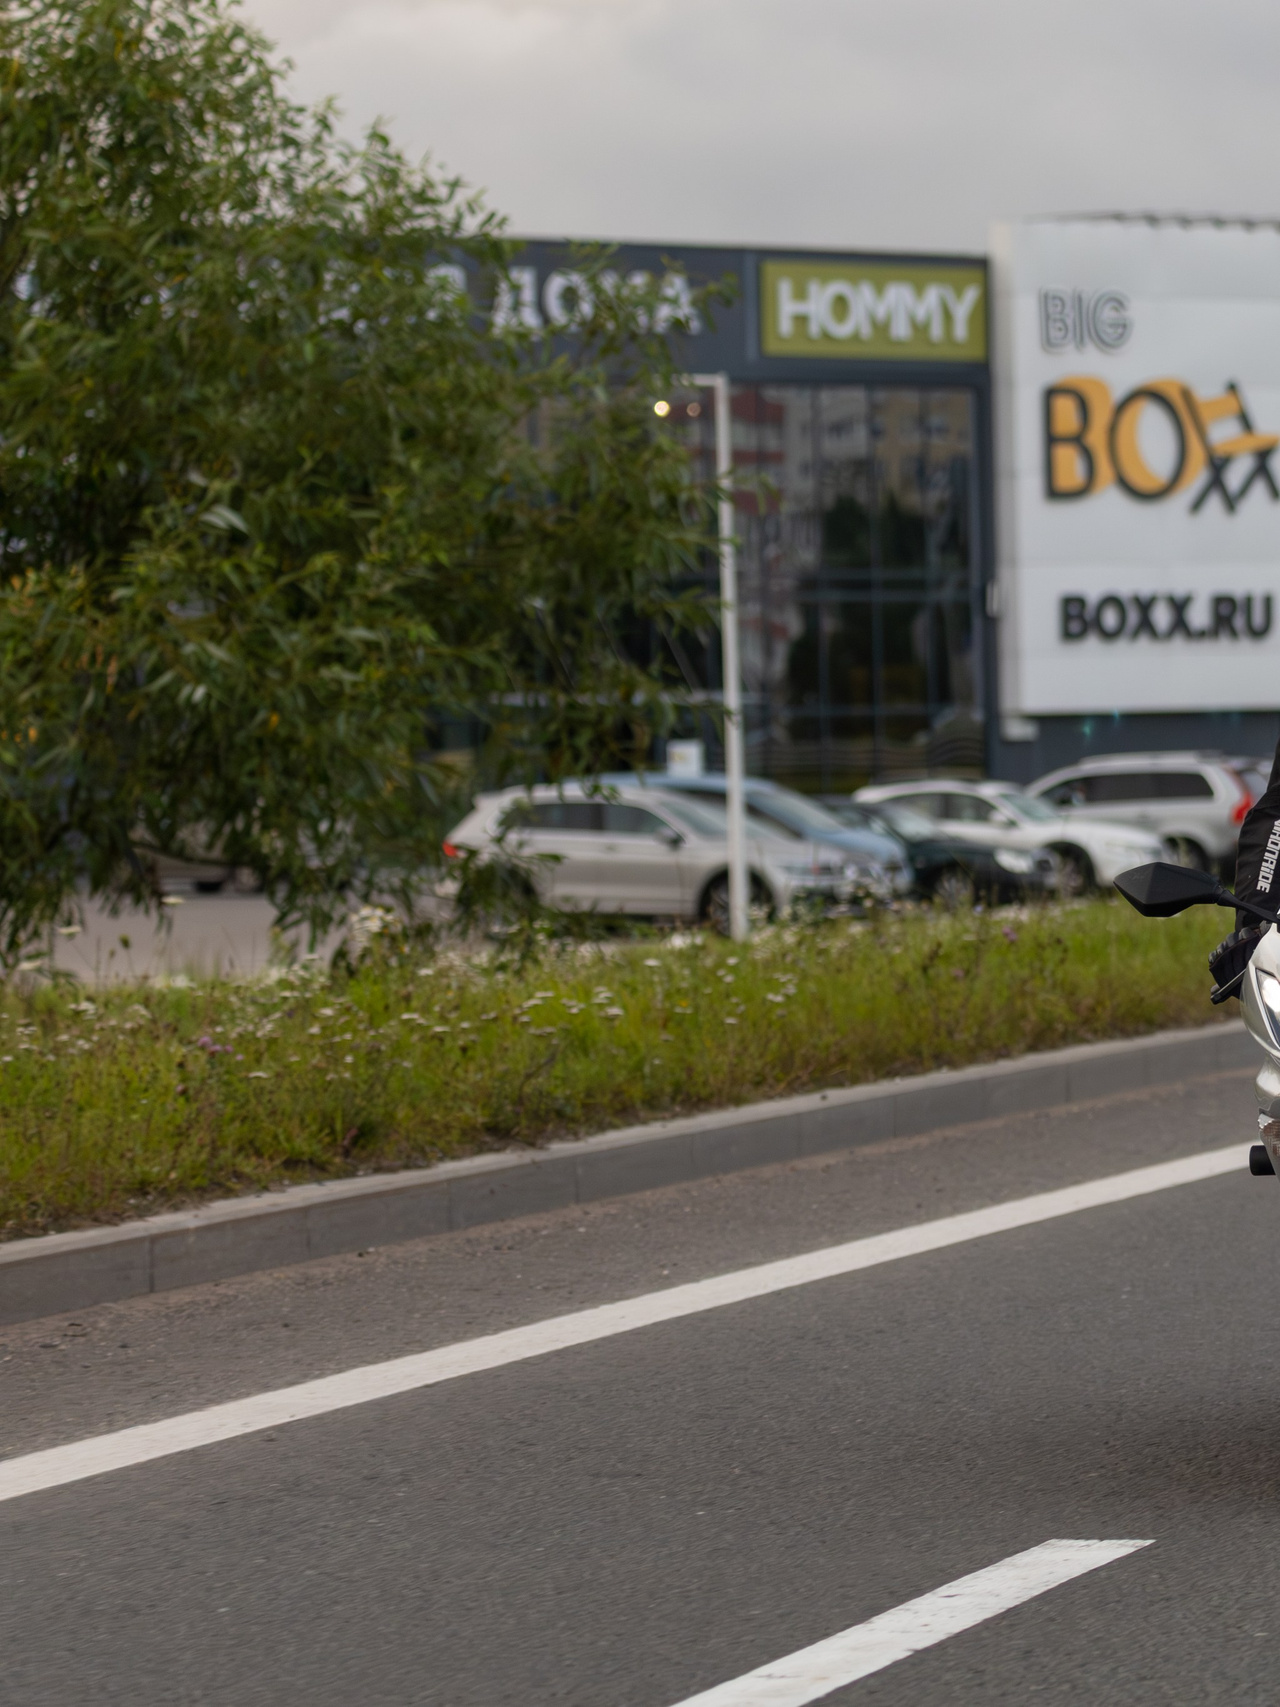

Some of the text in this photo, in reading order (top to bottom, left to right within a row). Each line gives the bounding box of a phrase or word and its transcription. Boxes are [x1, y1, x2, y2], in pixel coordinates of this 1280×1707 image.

[776, 278, 979, 344] HOMMY
[1040, 287, 1131, 352] BIG
[1060, 596, 1274, 642] BOXX.RU
